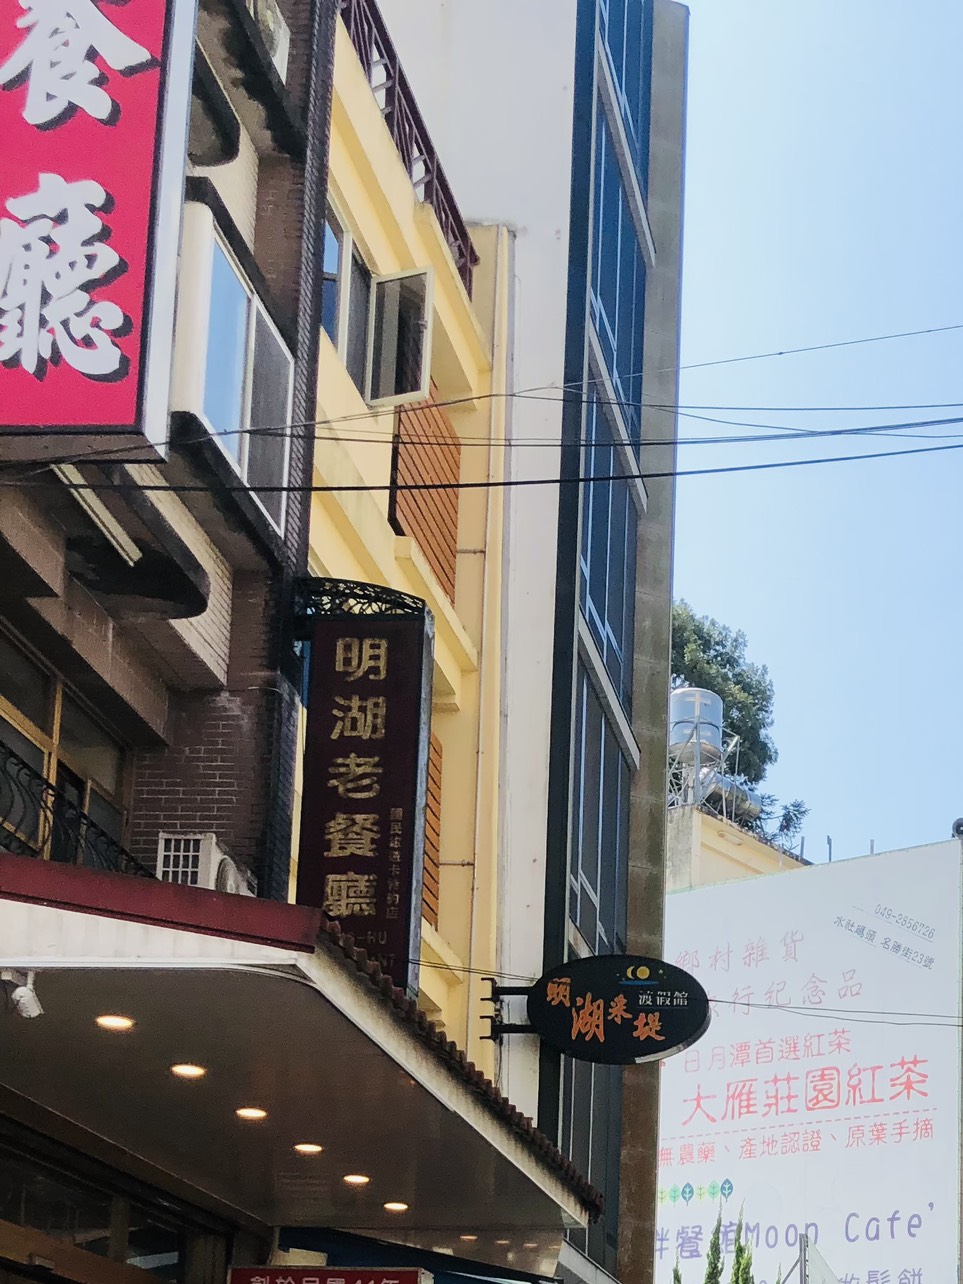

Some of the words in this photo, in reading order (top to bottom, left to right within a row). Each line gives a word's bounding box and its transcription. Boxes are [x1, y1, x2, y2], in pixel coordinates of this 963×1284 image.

[323, 636, 389, 918] 明湖老餐廳
[874, 903, 936, 939] 049-2856726
[675, 930, 805, 975] 鄉村雜貨
[638, 990, 689, 1006] 渡假館
[684, 1027, 852, 1073] 日月潭首選紅茶
[681, 1054, 930, 1127] 大雁莊園紅茶
